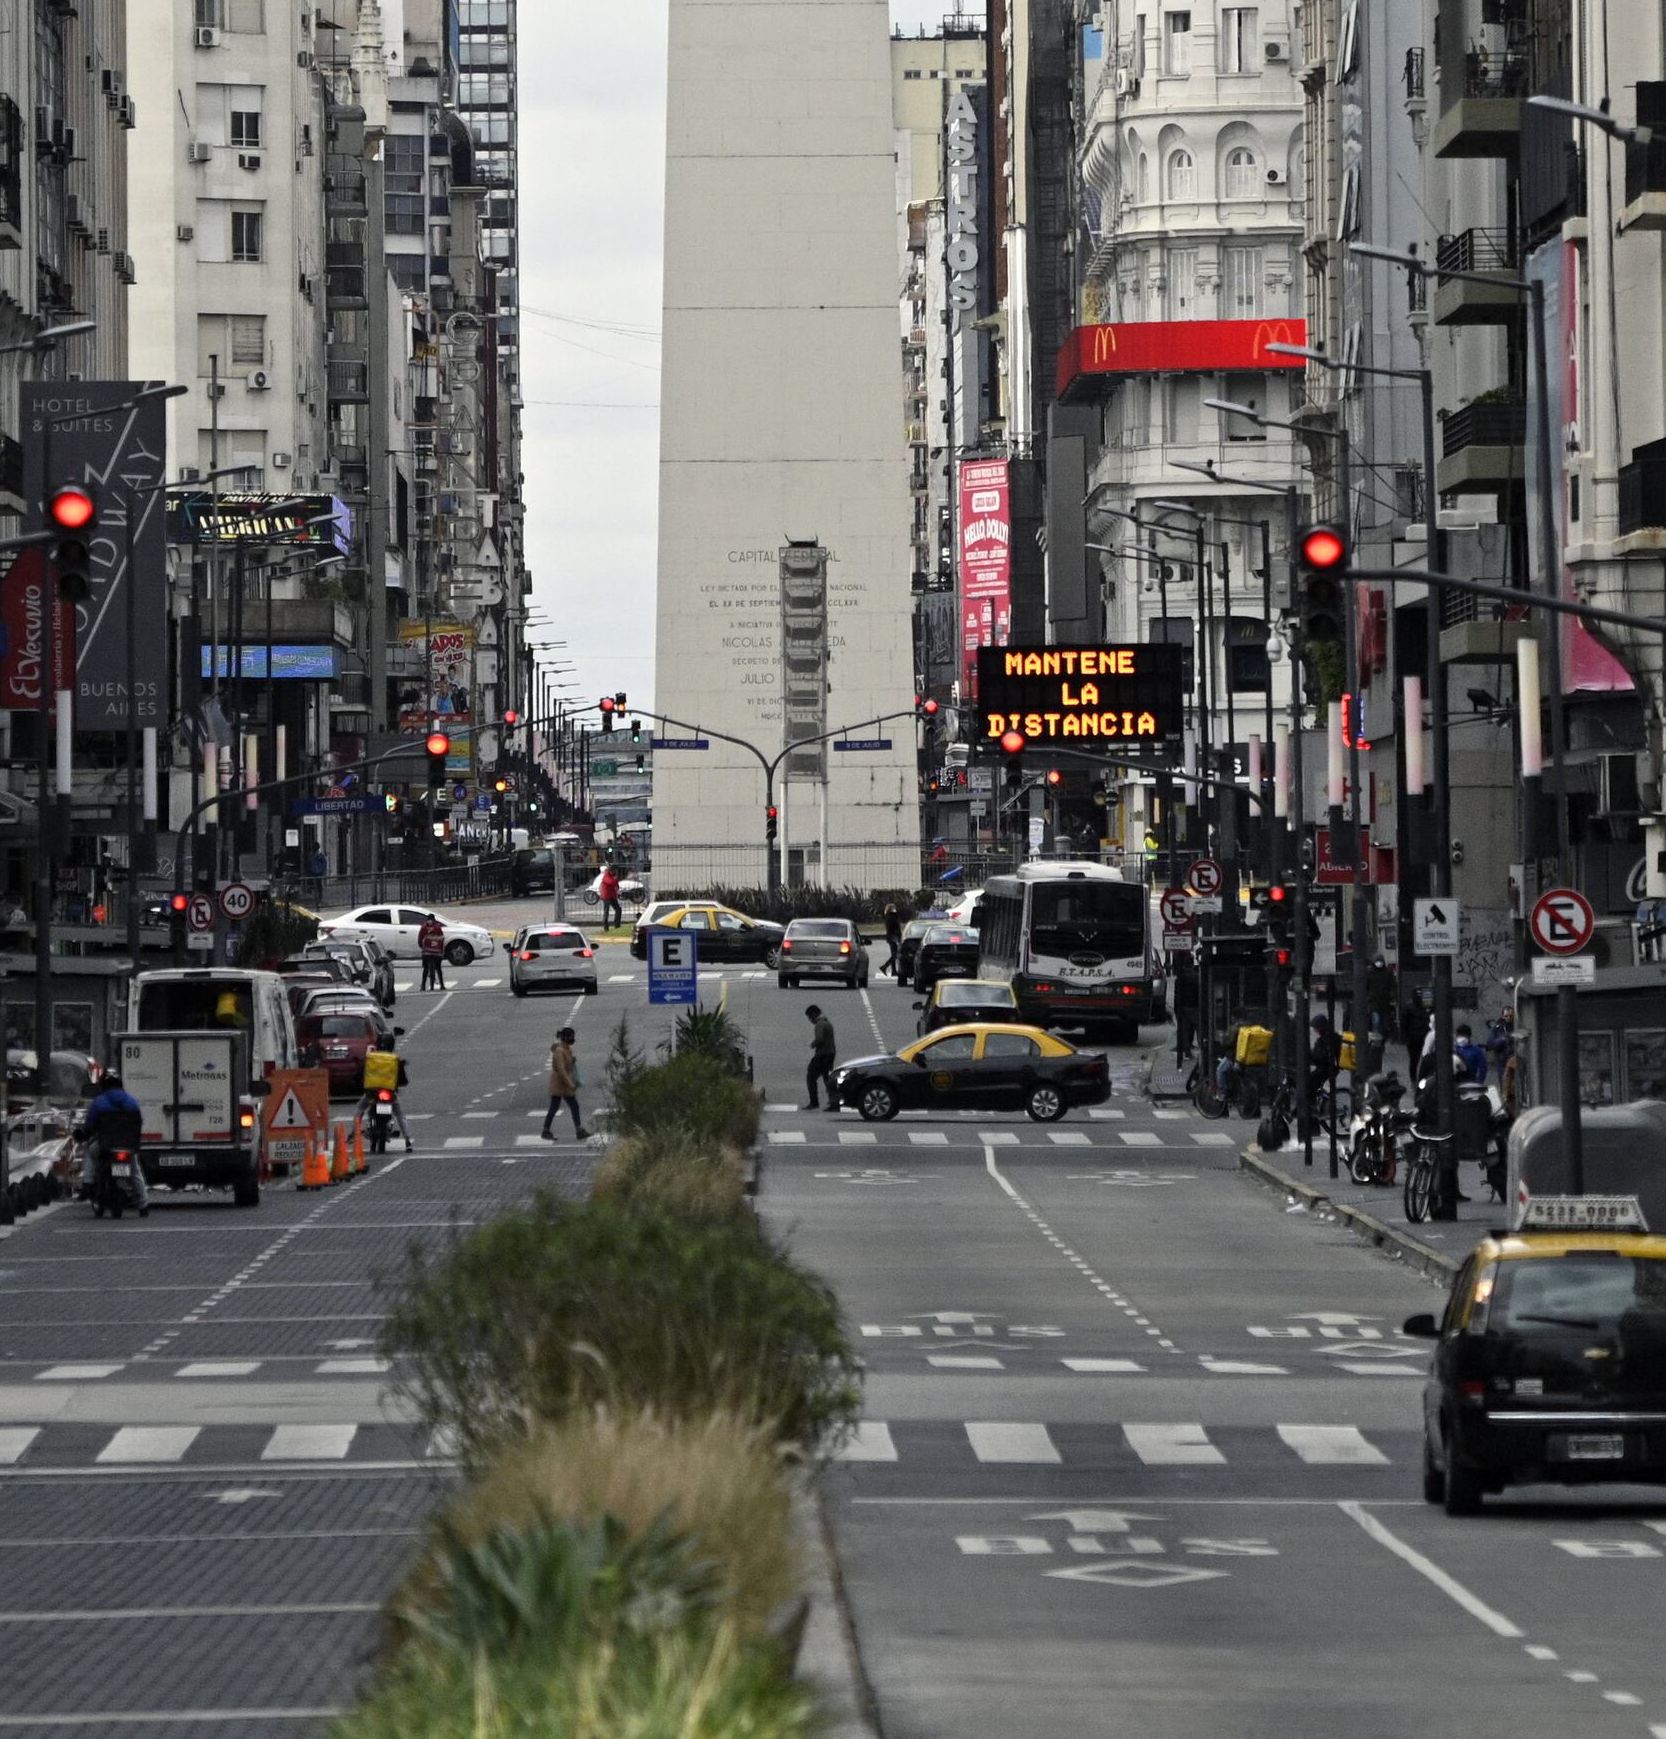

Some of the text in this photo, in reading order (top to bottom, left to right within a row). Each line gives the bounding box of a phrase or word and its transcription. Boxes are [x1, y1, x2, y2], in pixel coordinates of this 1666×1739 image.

[944, 91, 980, 311] ASTROS
[32, 399, 94, 414] HOTEL
[727, 550, 841, 564] CAPITAL EDEAL
[700, 585, 715, 593] LEY
[829, 584, 868, 592] NACIONAL
[749, 600, 782, 608] SEPTIEM
[1004, 650, 1136, 677] MANTENE
[740, 672, 775, 685] JULIO
[80, 682, 157, 697] BUENOS
[1061, 681, 1099, 706] LA
[105, 701, 157, 716] AIES
[986, 711, 1156, 738] DISTANCIA
[314, 799, 365, 812] LIBERTAD
[1319, 861, 1368, 873] ABIERO
[227, 893, 248, 909] 40
[662, 939, 681, 966] E
[274, 1150, 304, 1160] REDUCI
